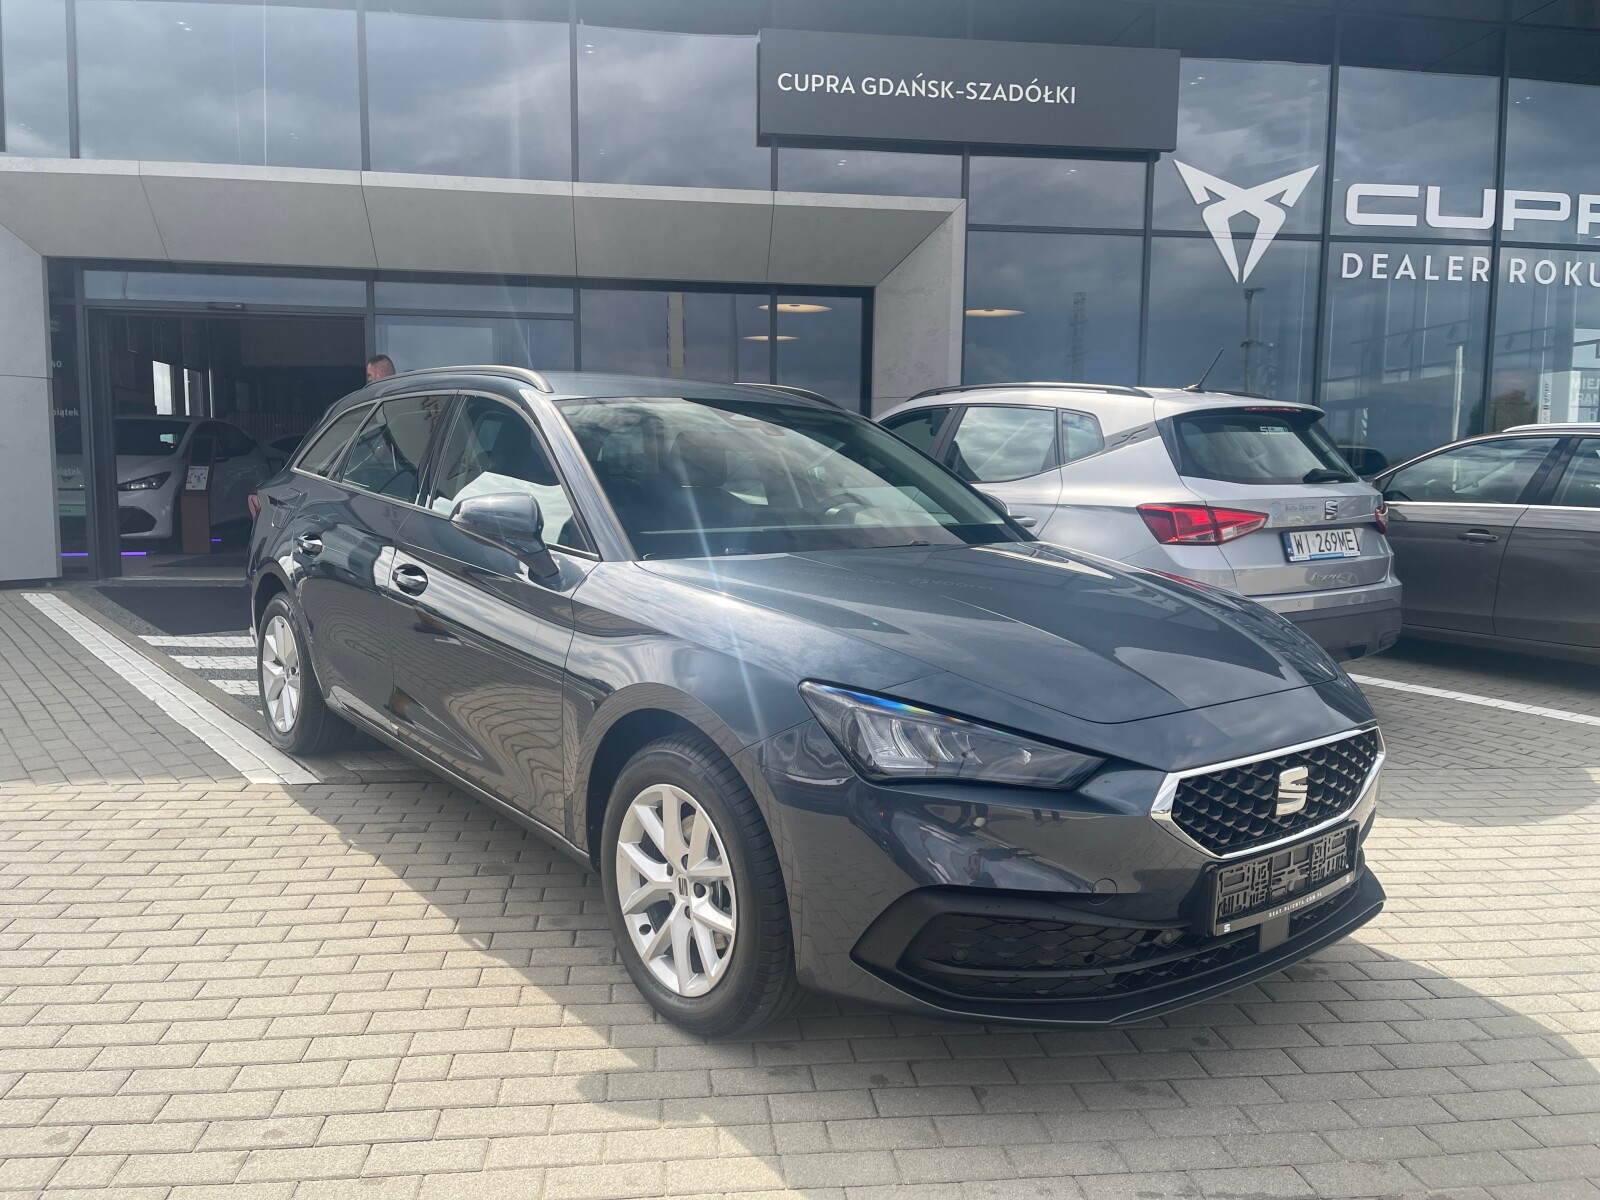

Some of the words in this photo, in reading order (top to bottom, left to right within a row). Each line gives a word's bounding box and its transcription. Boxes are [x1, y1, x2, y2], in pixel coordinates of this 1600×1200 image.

[777, 72, 856, 94] CUPRA
[861, 73, 1076, 104] GDAŃSK-SZADÓŁKI
[1342, 252, 1490, 282] DEALER
[1509, 258, 1600, 288] ROKU
[1293, 533, 1311, 555] WI
[1315, 531, 1355, 553] 269ME
